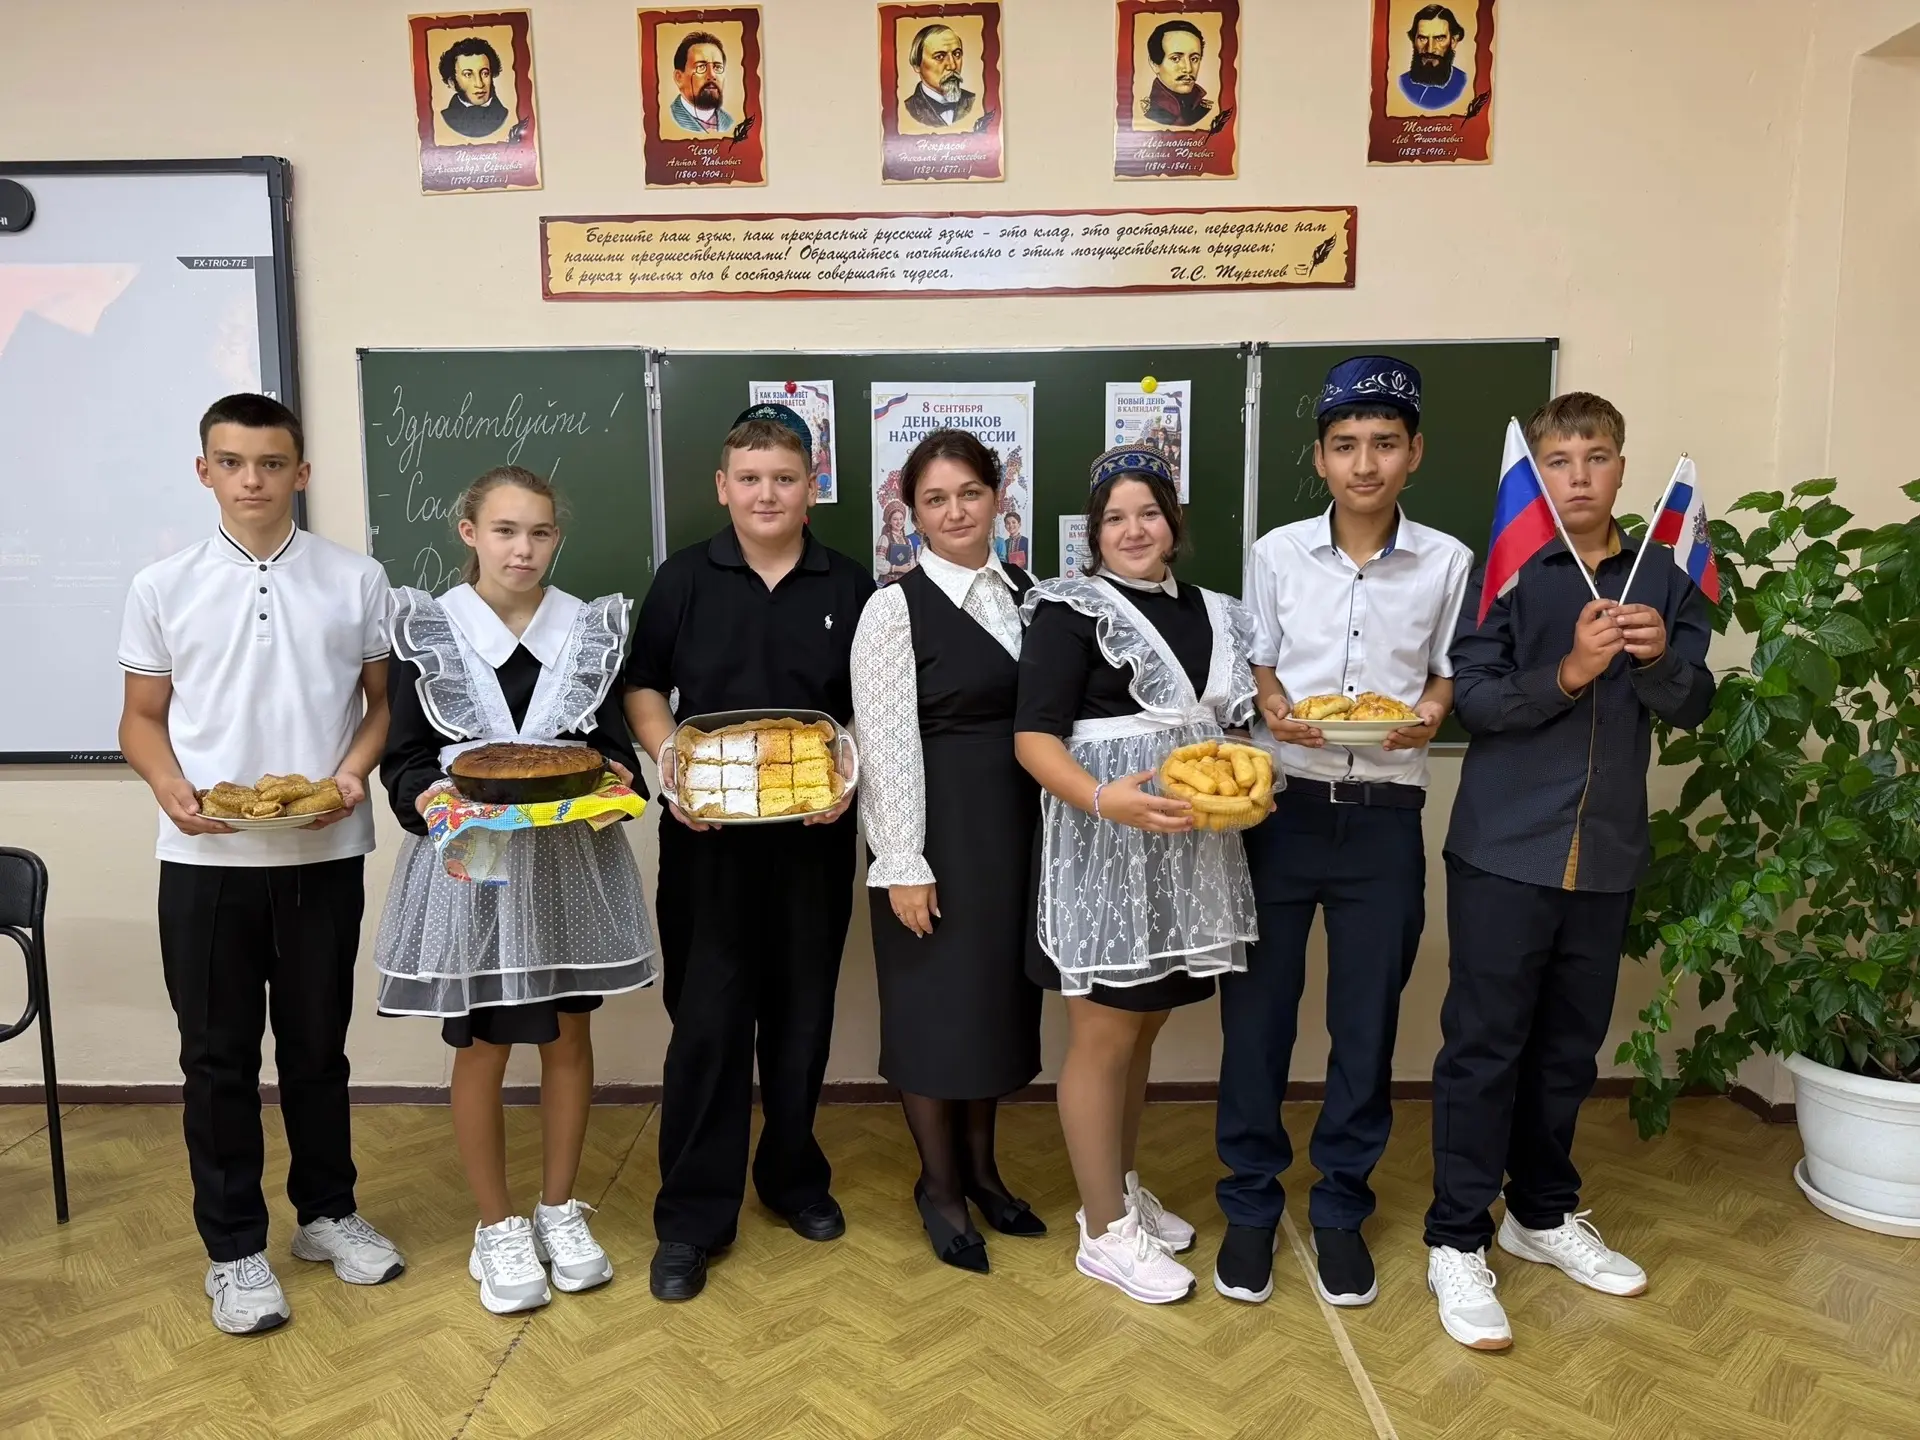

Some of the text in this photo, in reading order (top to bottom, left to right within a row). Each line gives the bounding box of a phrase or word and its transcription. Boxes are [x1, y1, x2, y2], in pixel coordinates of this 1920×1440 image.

[1402, 121, 1453, 133] Толстой
[1142, 136, 1205, 149] Лермонтов
[1392, 133, 1464, 144] Лев Николаевич
[687, 144, 720, 156] Чехов
[916, 139, 967, 152] Некрасов
[455, 150, 499, 163] Пушкин
[898, 152, 937, 162] Николай
[1133, 148, 1215, 159] Михаил Юрьевич
[666, 155, 742, 167] Антон Павлович
[433, 164, 480, 175] Александр
[586, 227, 653, 247] Берегите
[659, 230, 691, 243] наш
[696, 230, 736, 248] язык,
[743, 229, 775, 242] наш
[780, 228, 869, 246] прекрасный
[874, 227, 933, 245] русский
[938, 228, 974, 244] язык
[999, 225, 1027, 239] это
[1034, 227, 1074, 243] клад,
[1081, 224, 1110, 237] это
[1117, 222, 1198, 242] достояние,
[1205, 221, 1289, 238] переданное
[1294, 221, 1327, 234] нам
[564, 239, 1276, 267] нашими предшественниками! Обращайтесь почтительно с этим могущественным орудием;
[193, 259, 247, 268] FX-TRIO-77E
[565, 264, 954, 286] в руках умелых оно в состоянии совершать чудеса.
[1215, 263, 1290, 281] Тургенев
[760, 391, 771, 399] КАК
[922, 402, 983, 413] 8 СЕНТЯБРЯ
[1117, 397, 1165, 406] НОВЫЙ ДЕНЬ
[902, 416, 1001, 429] ДЕНЬ ЯЗЫКОВ
[1165, 414, 1172, 424] 8
[889, 431, 1016, 442] НАРО ОССИИ
